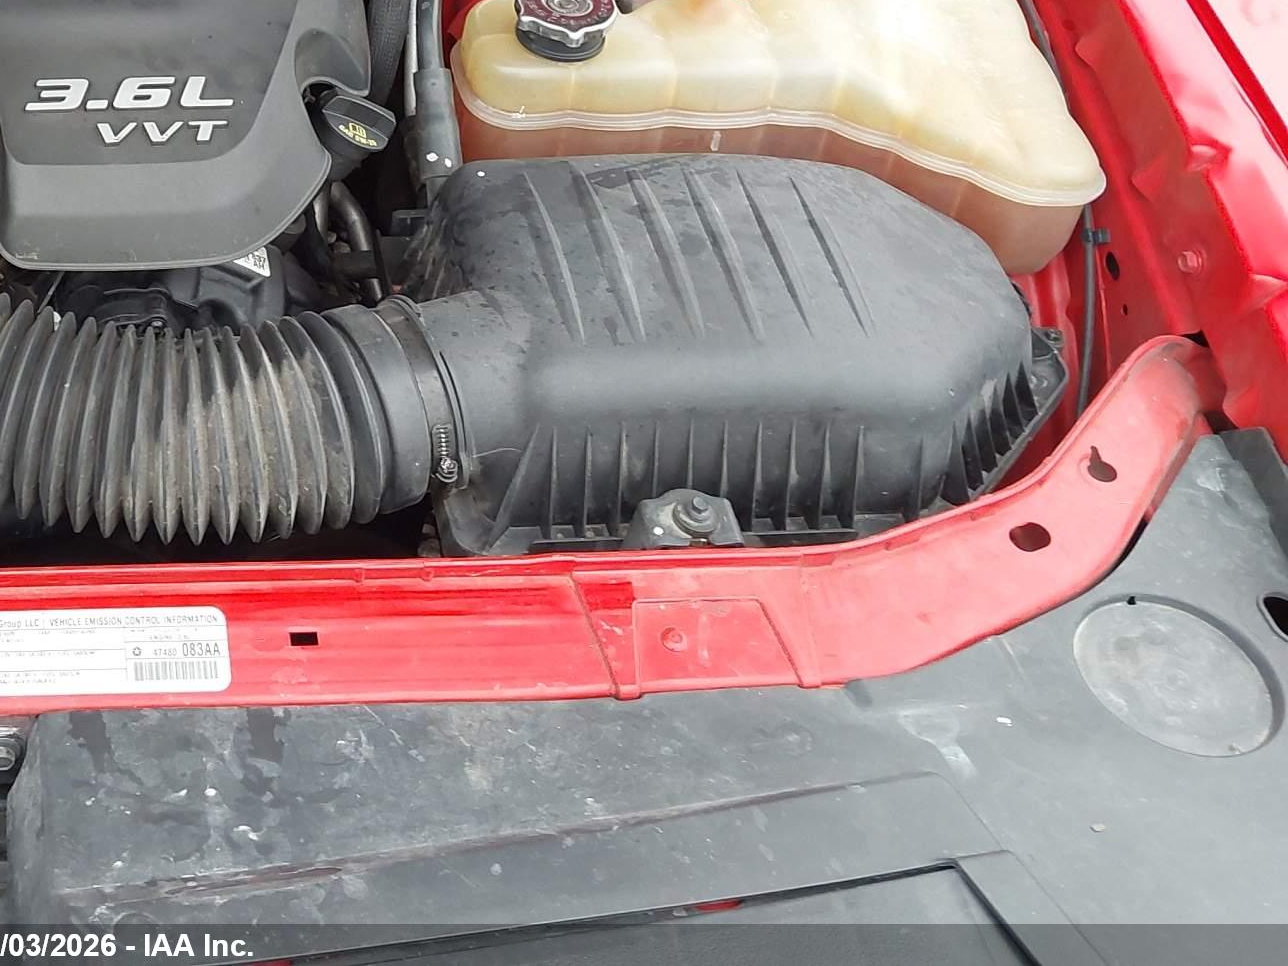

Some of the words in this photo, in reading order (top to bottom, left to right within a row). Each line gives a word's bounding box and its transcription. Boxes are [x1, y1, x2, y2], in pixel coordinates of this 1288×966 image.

[25, 76, 235, 111] 3.6L
[96, 120, 228, 146] VVT
[24, 616, 40, 628] LLC
[49, 614, 82, 627] VEHICLE
[84, 613, 122, 626] EMISSION
[124, 612, 160, 626] CONTROL
[163, 610, 219, 624] INFORMATION
[182, 642, 221, 657] 083AA
